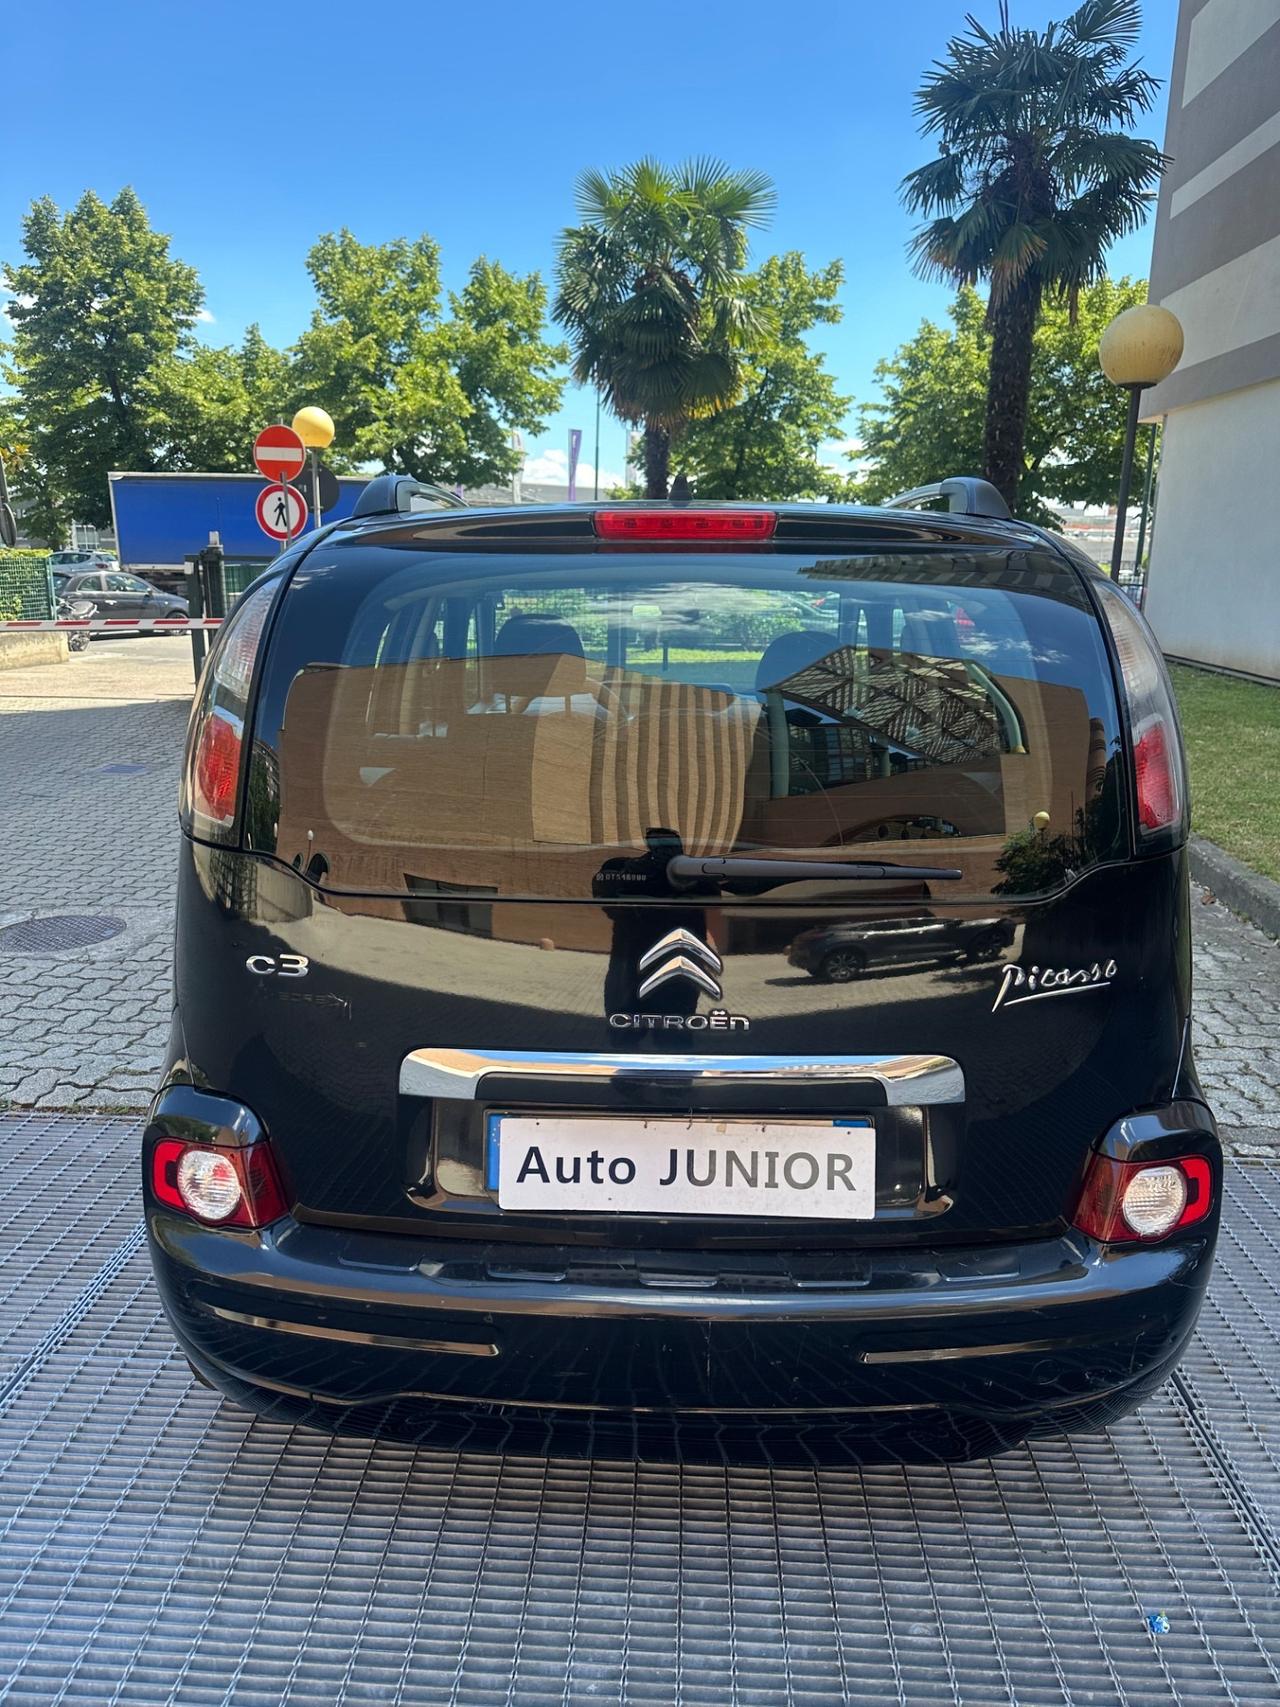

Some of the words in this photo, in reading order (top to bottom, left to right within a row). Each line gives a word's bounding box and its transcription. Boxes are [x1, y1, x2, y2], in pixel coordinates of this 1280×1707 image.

[245, 953, 310, 978] C3
[991, 959, 1118, 1013] Picasso
[516, 1145, 637, 1186] Auto
[659, 1148, 857, 1192] JUNIOR
